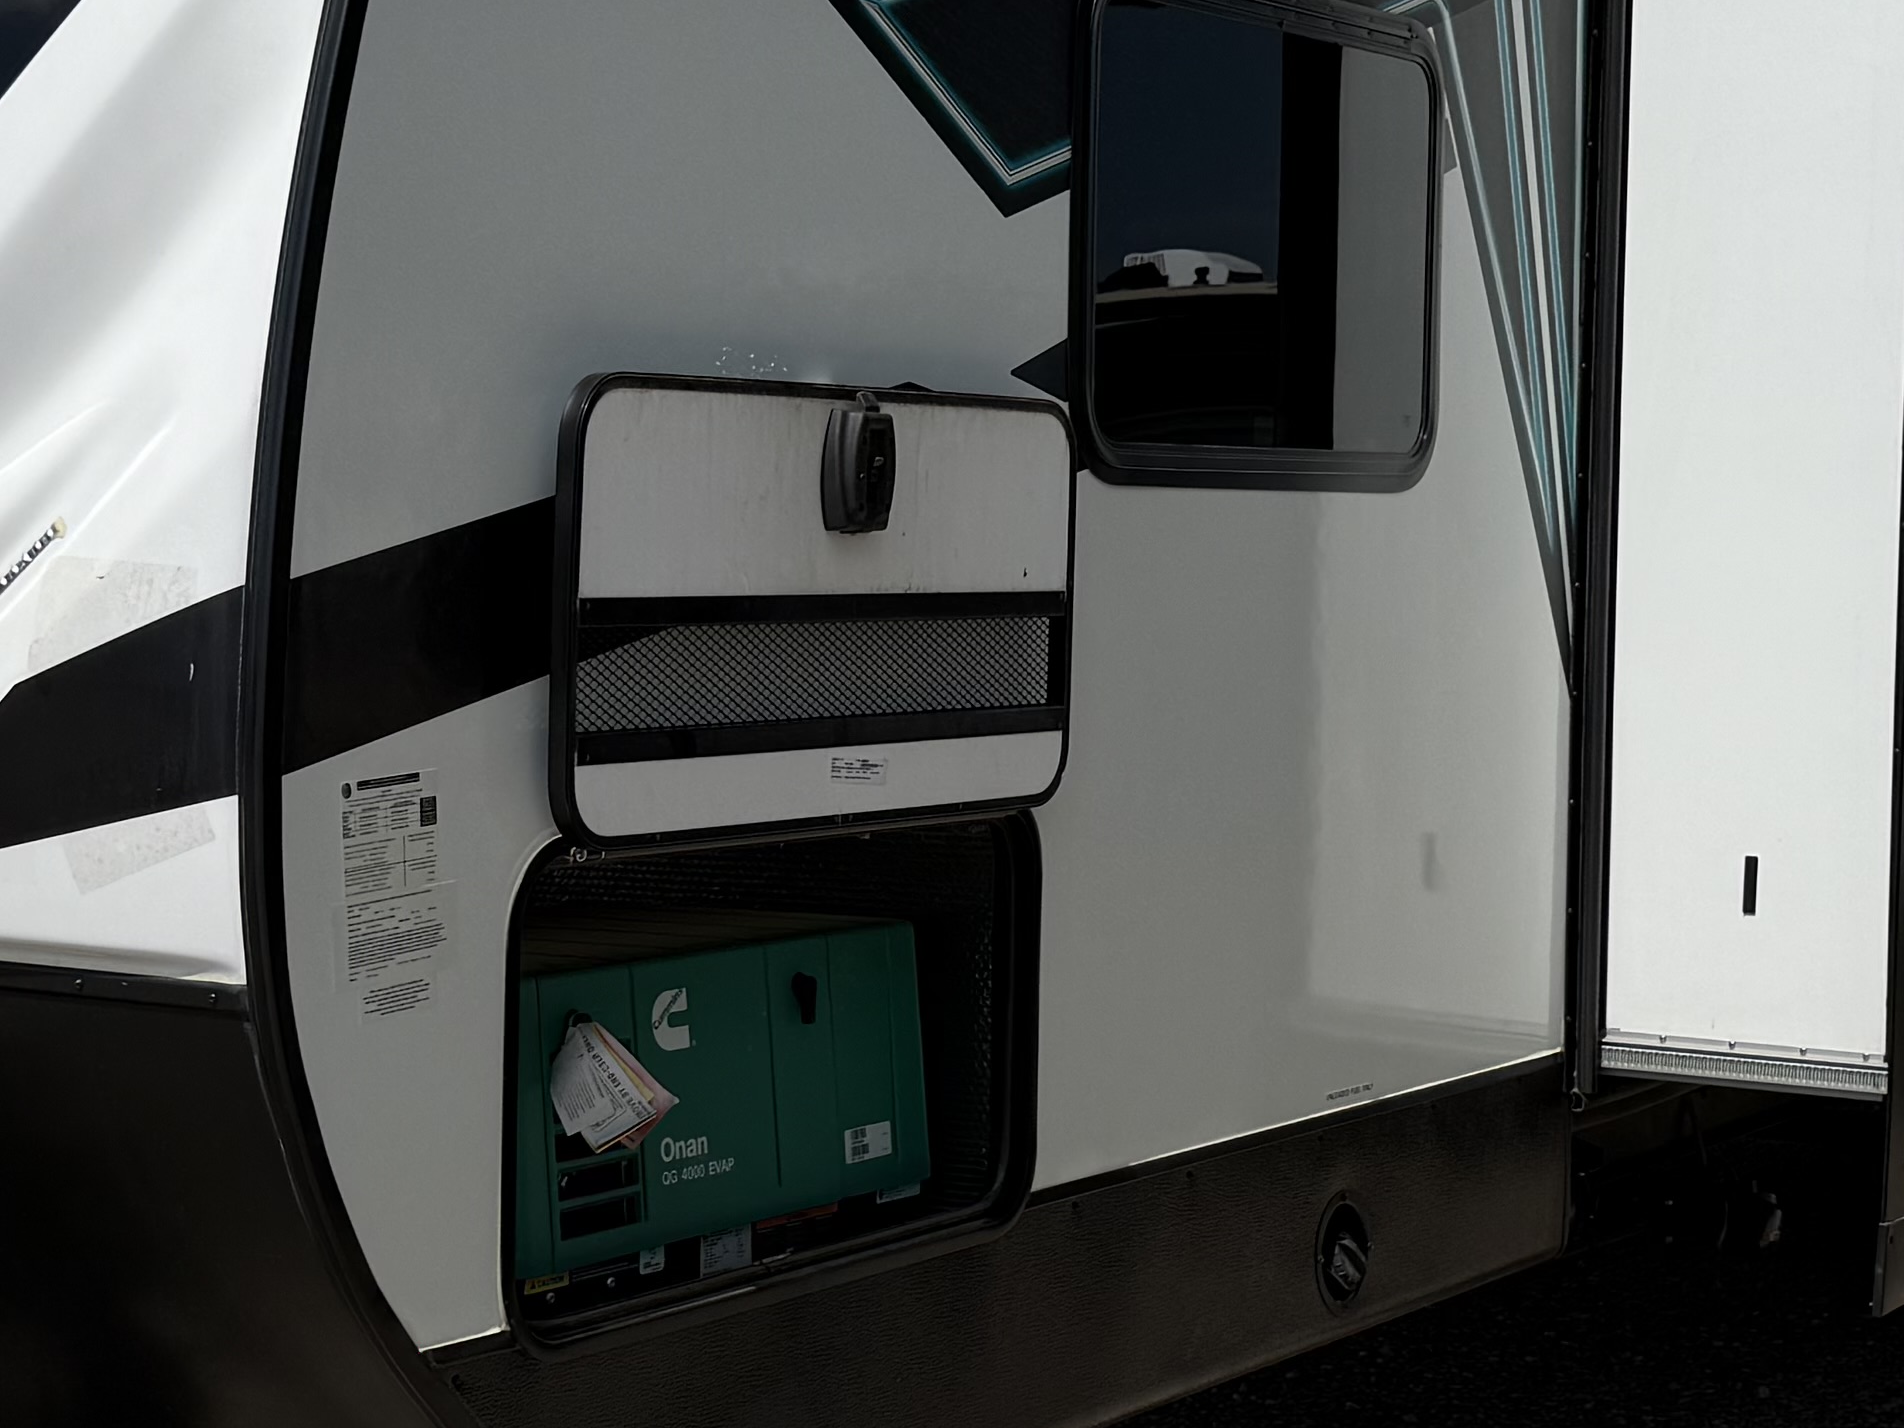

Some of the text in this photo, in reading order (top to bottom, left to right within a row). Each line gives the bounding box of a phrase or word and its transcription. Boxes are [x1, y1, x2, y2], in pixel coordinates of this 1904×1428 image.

[660, 1136, 709, 1163] Onan
[682, 1164, 705, 1180] 4000
[709, 1157, 735, 1176] EVAP
